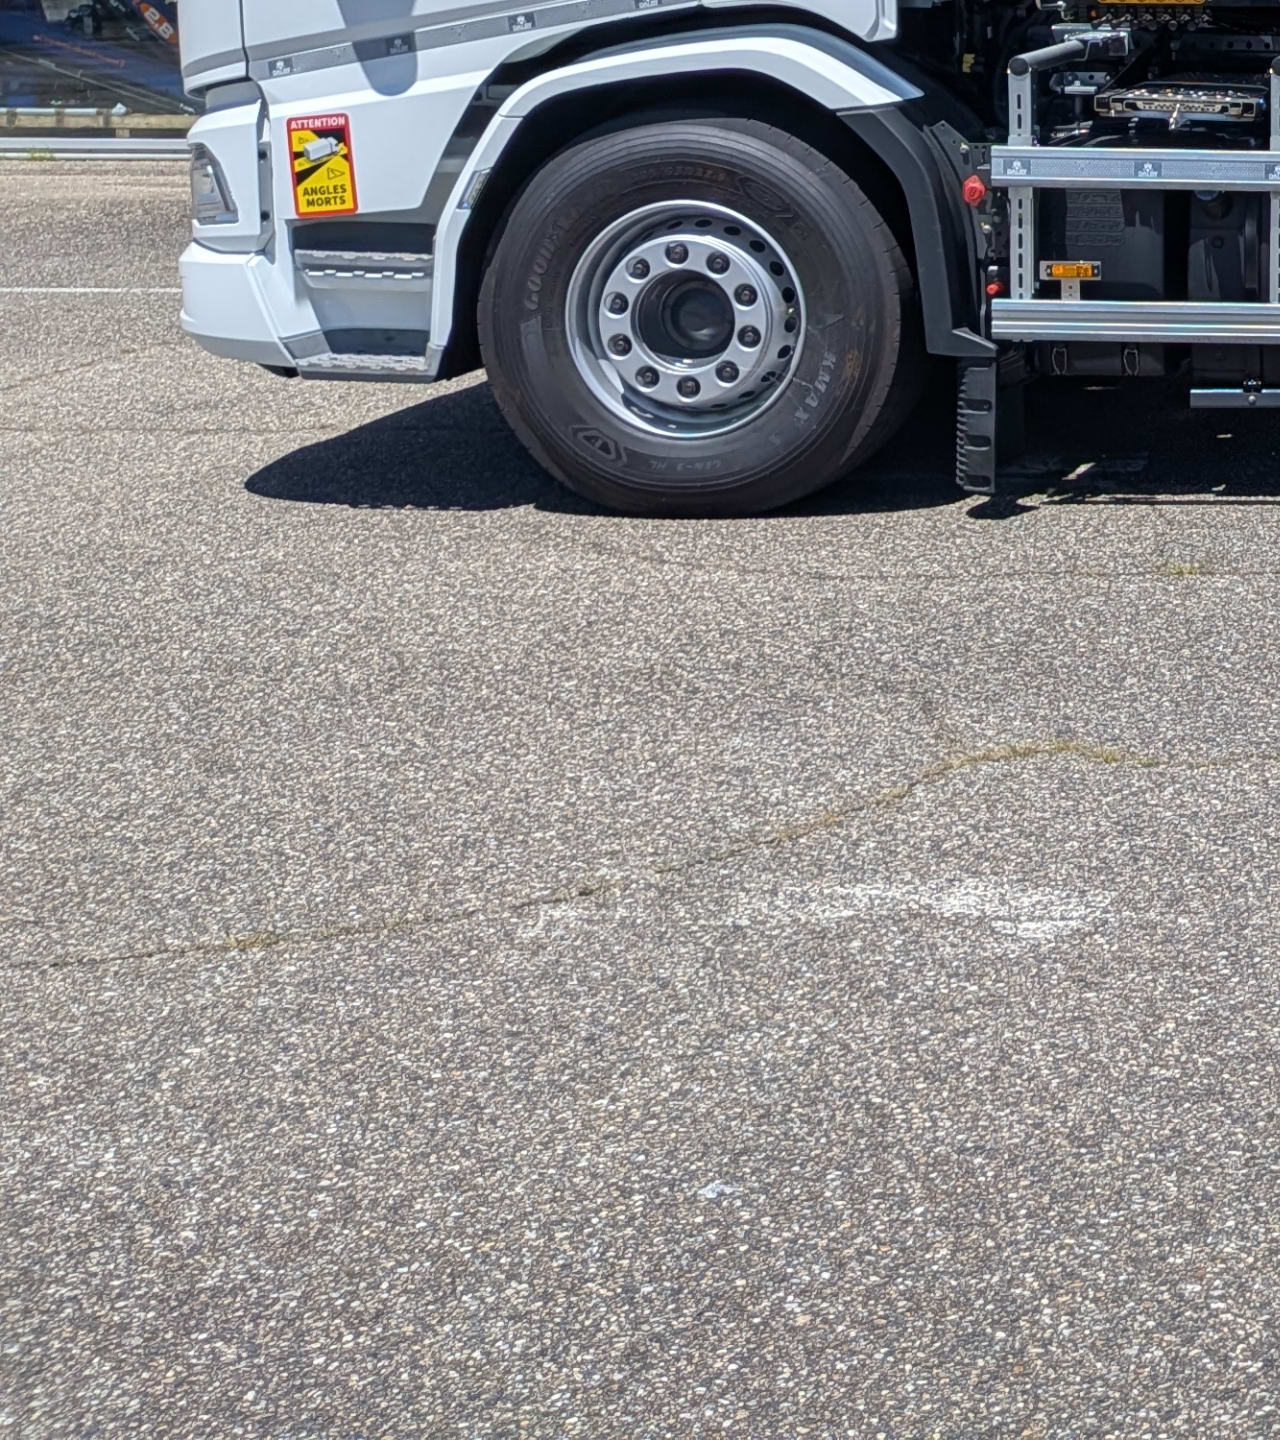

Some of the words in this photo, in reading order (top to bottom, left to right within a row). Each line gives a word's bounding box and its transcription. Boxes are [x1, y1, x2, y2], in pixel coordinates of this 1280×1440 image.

[290, 116, 345, 129] ATTENTION
[302, 184, 347, 197] ANGLES
[306, 195, 346, 208] MORTS
